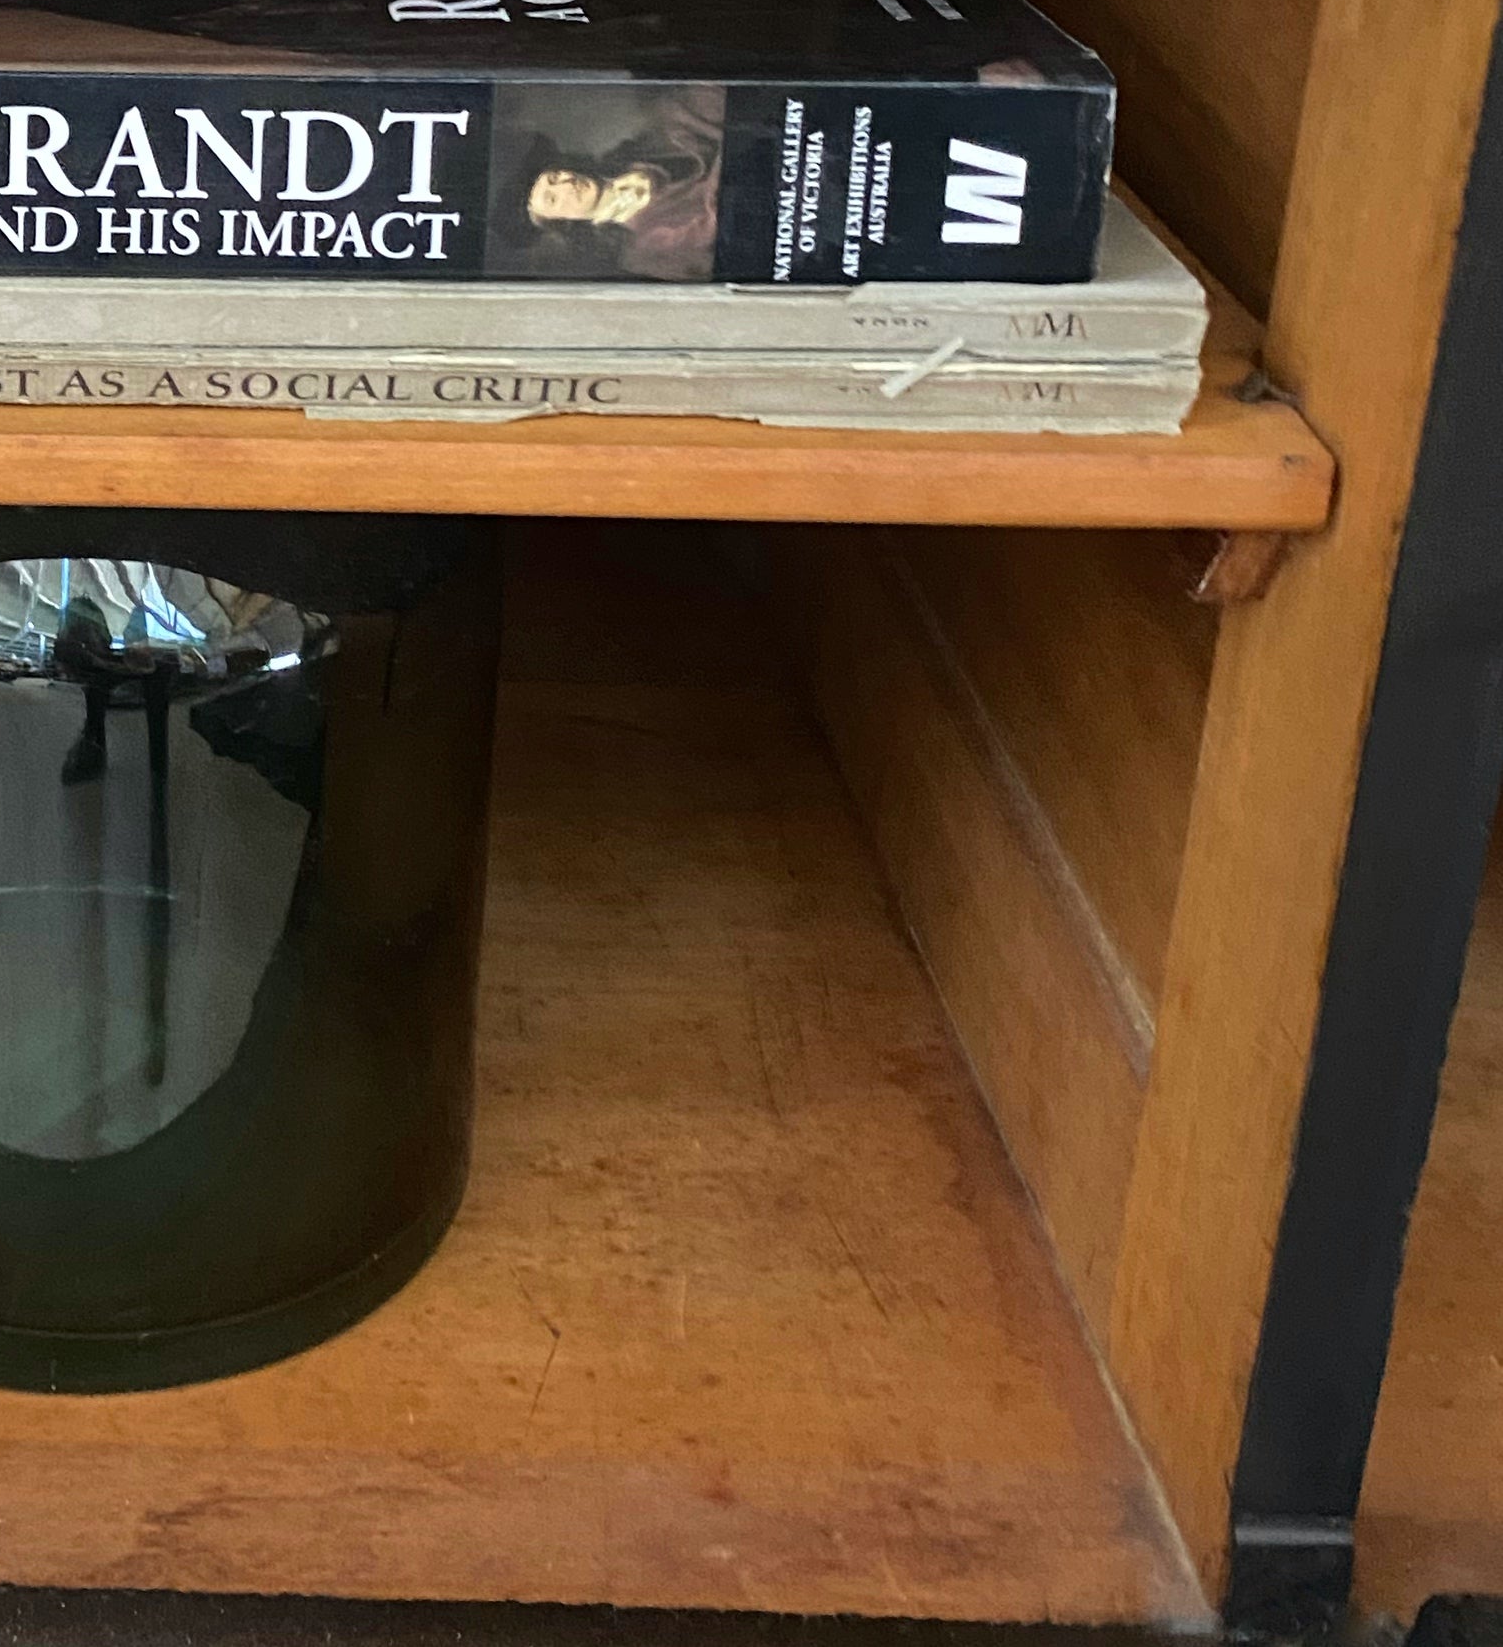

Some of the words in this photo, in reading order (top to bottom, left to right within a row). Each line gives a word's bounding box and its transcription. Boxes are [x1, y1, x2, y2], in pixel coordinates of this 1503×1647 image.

[524, 6, 591, 24] A
[780, 97, 805, 183] GALLERY
[845, 105, 873, 239] EXHIBITIONS
[800, 129, 825, 224] VICTORIA
[867, 140, 892, 247] AUSTRALIA
[97, 206, 202, 258] HIS
[217, 208, 461, 261] IMPACT
[772, 185, 798, 282] NATIONAL
[798, 225, 818, 253] OF
[841, 240, 862, 279] ART
[57, 368, 126, 399] AS
[149, 369, 185, 400] A
[204, 370, 415, 403] SOCIAL
[432, 374, 624, 405] CRITIC
